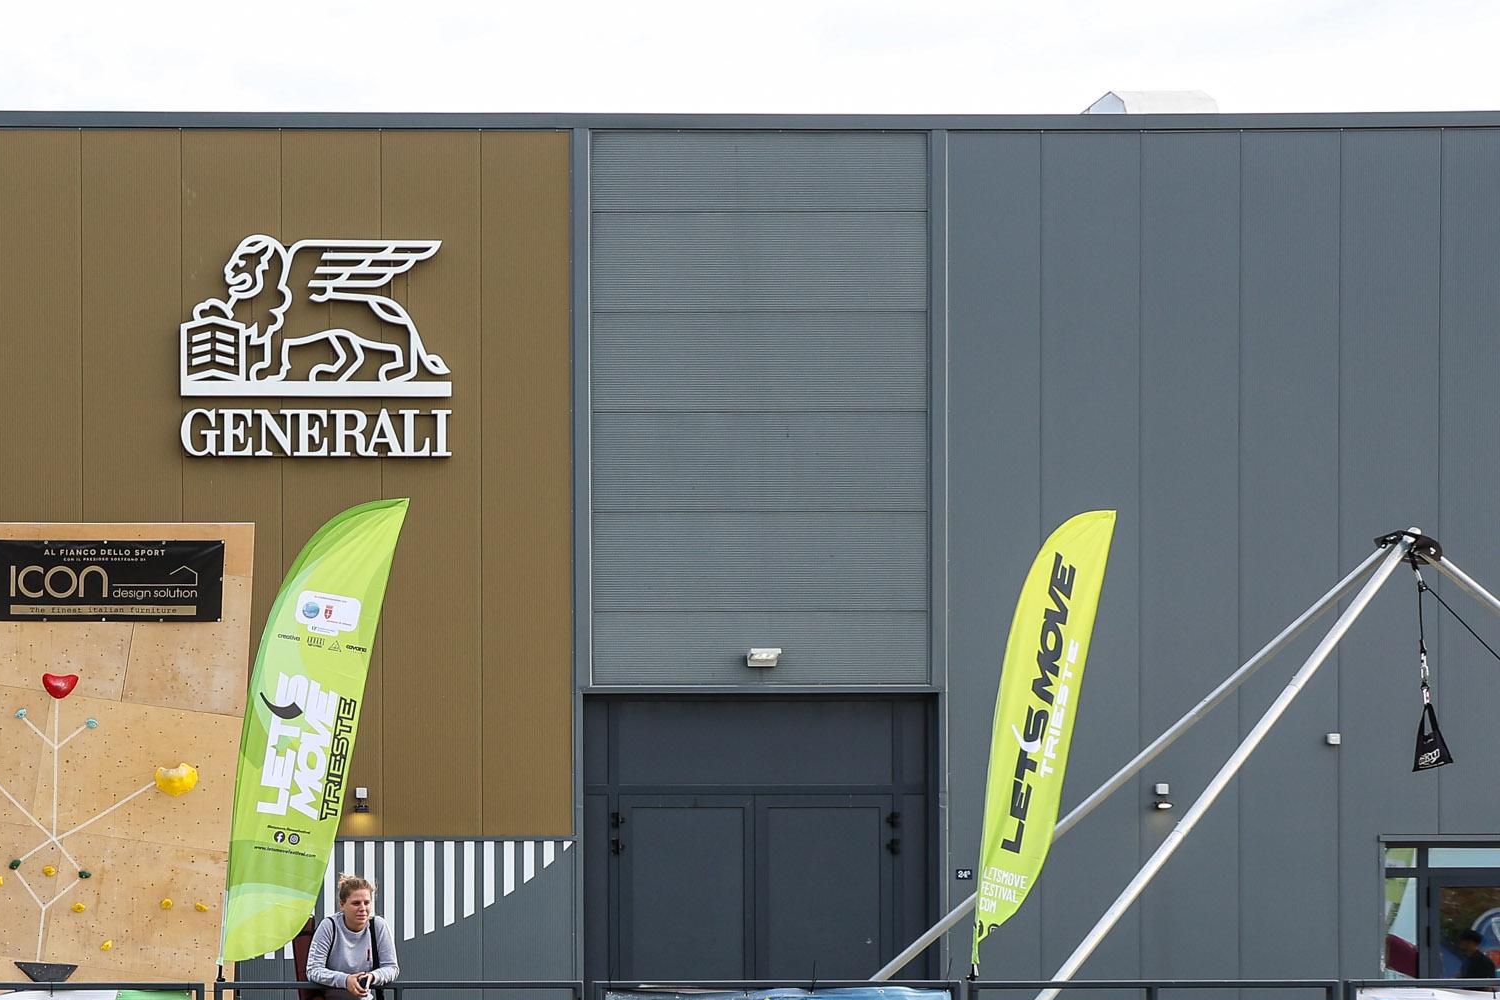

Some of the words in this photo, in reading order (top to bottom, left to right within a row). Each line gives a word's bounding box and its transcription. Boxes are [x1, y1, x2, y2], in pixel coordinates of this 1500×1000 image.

[180, 408, 452, 457] GENERALI
[112, 587, 151, 599] design
[154, 587, 198, 598] solution
[130, 606, 177, 614] furniture
[1031, 551, 1076, 706] MOVE
[290, 679, 339, 820] MOVE
[1040, 638, 1080, 778] TRIESTE
[320, 696, 356, 821] TRIESTE
[984, 866, 1028, 889] LETSMOVE
